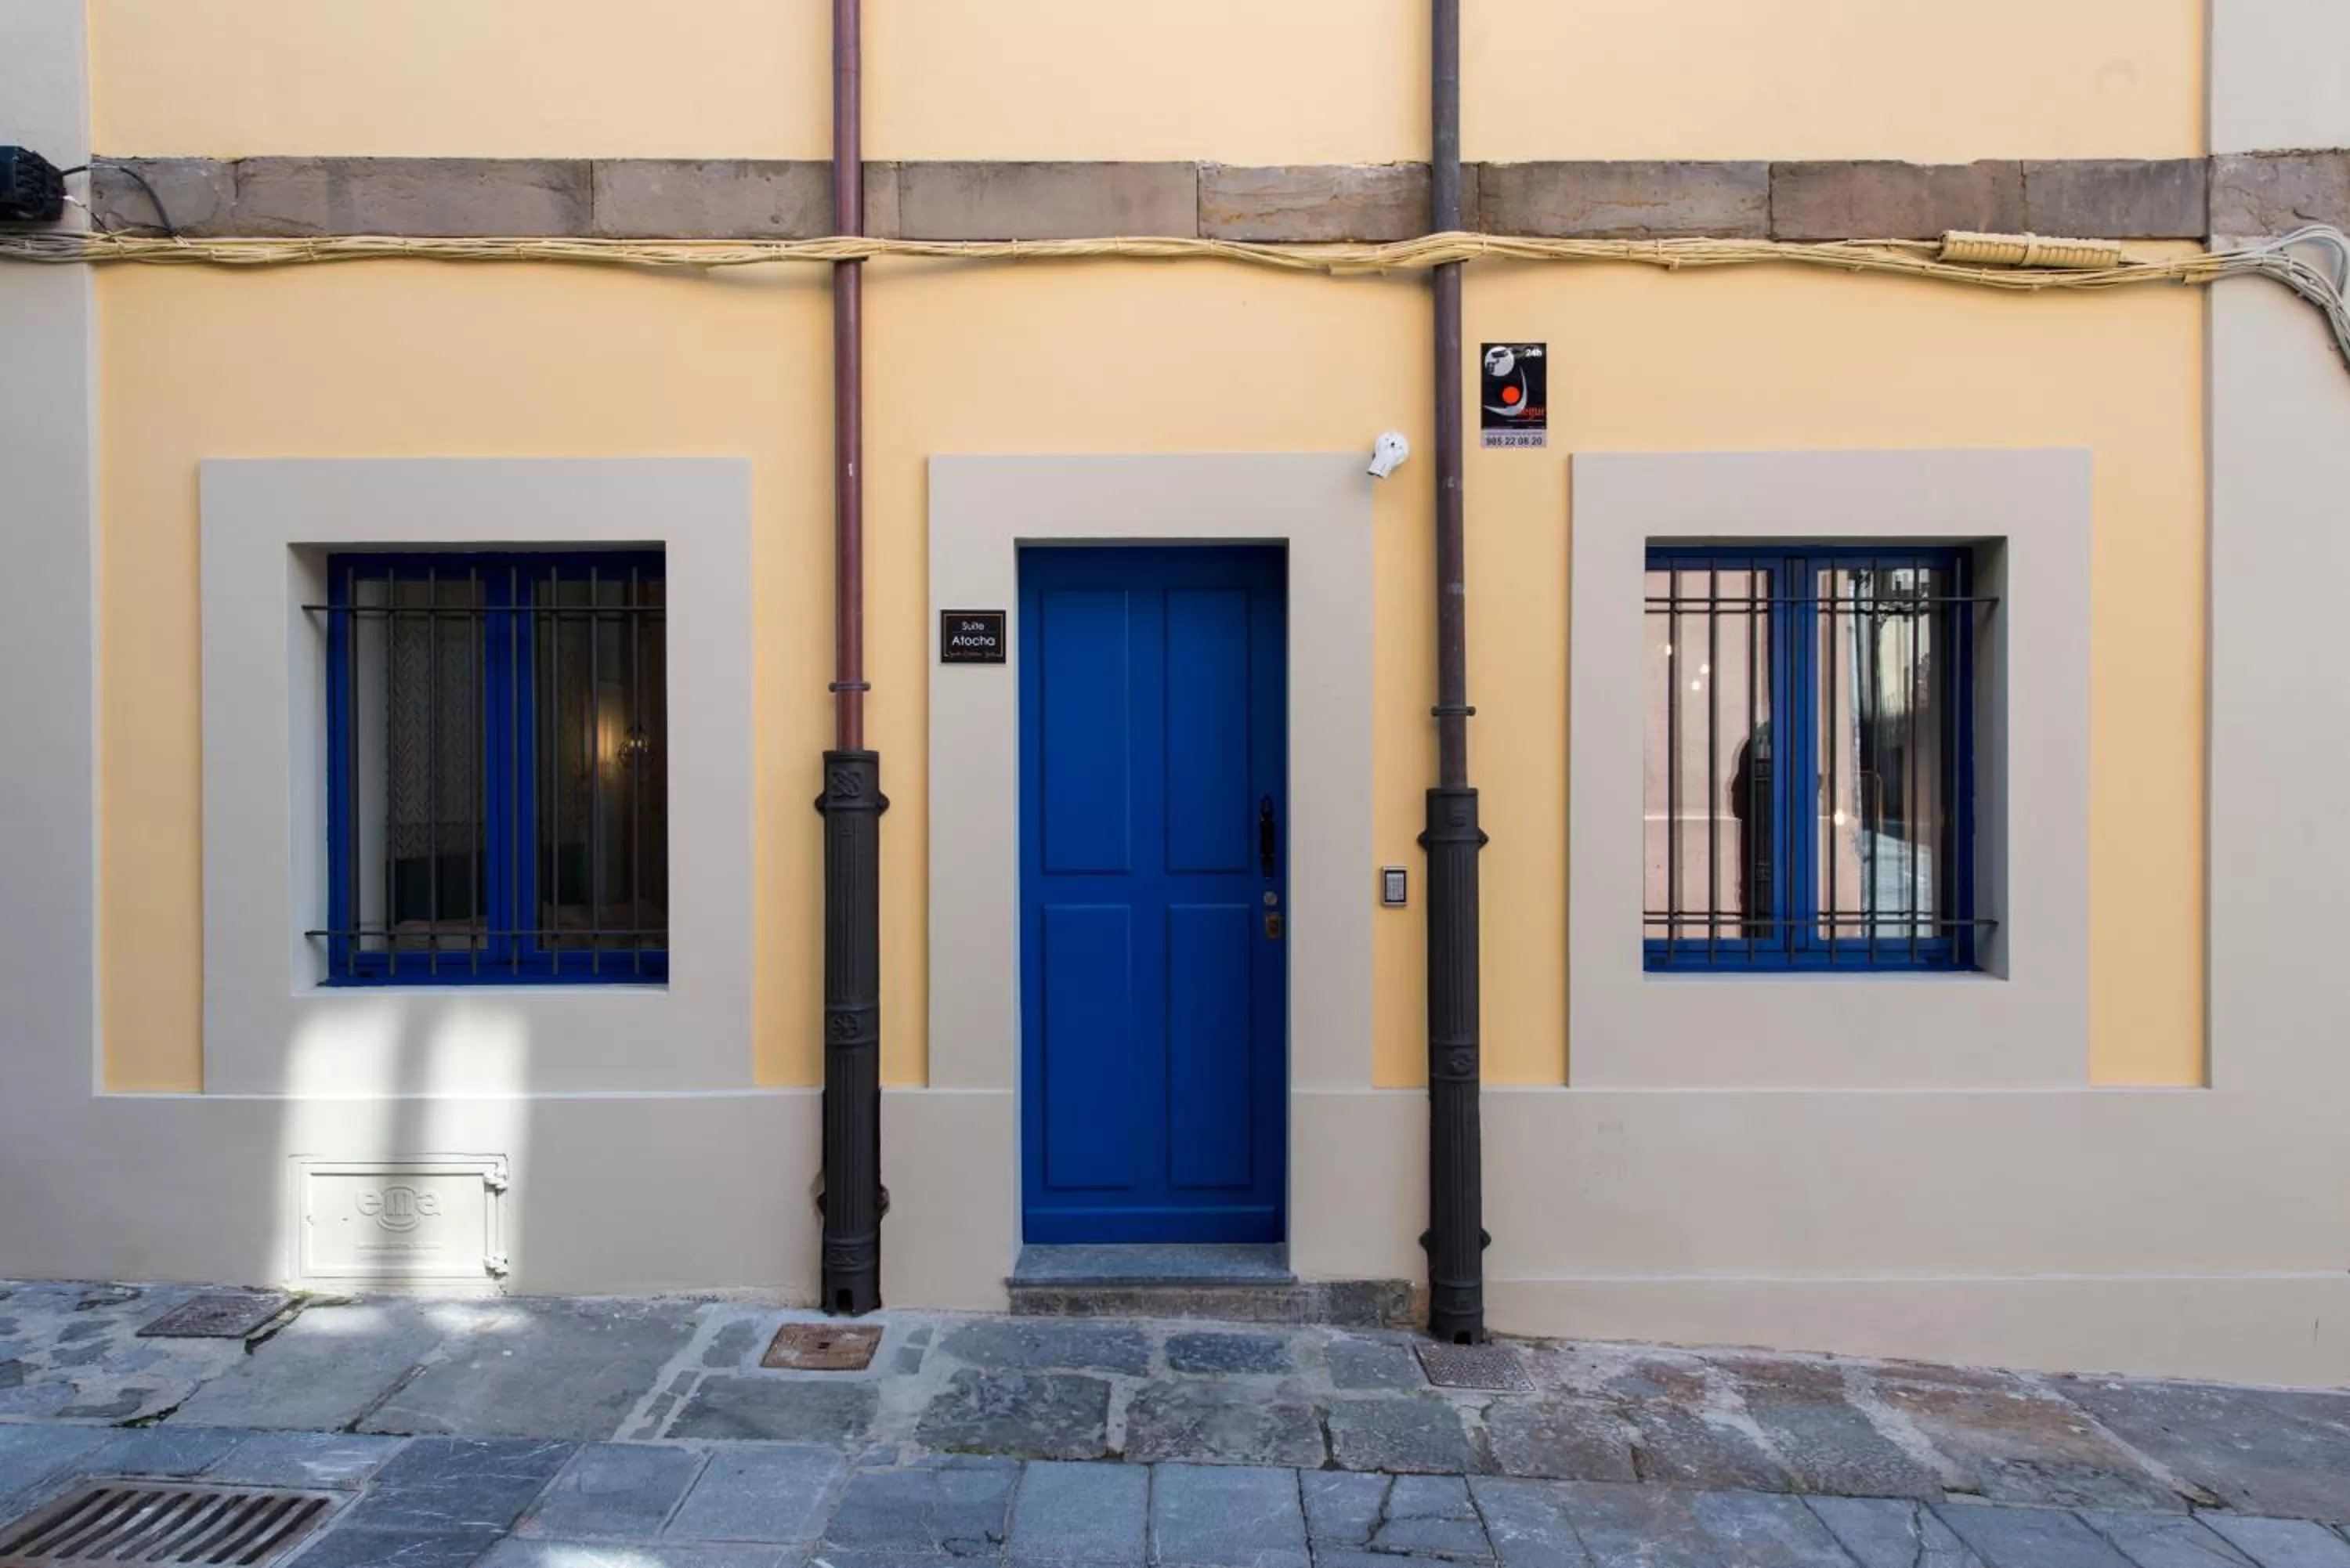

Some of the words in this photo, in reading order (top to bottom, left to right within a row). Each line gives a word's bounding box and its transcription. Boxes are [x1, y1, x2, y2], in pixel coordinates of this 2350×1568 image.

[1525, 347, 1542, 357] 24h
[1505, 436, 1516, 446] 22
[1531, 436, 1542, 446] 20
[961, 620, 985, 630] Suite
[952, 635, 996, 646] Atocha
